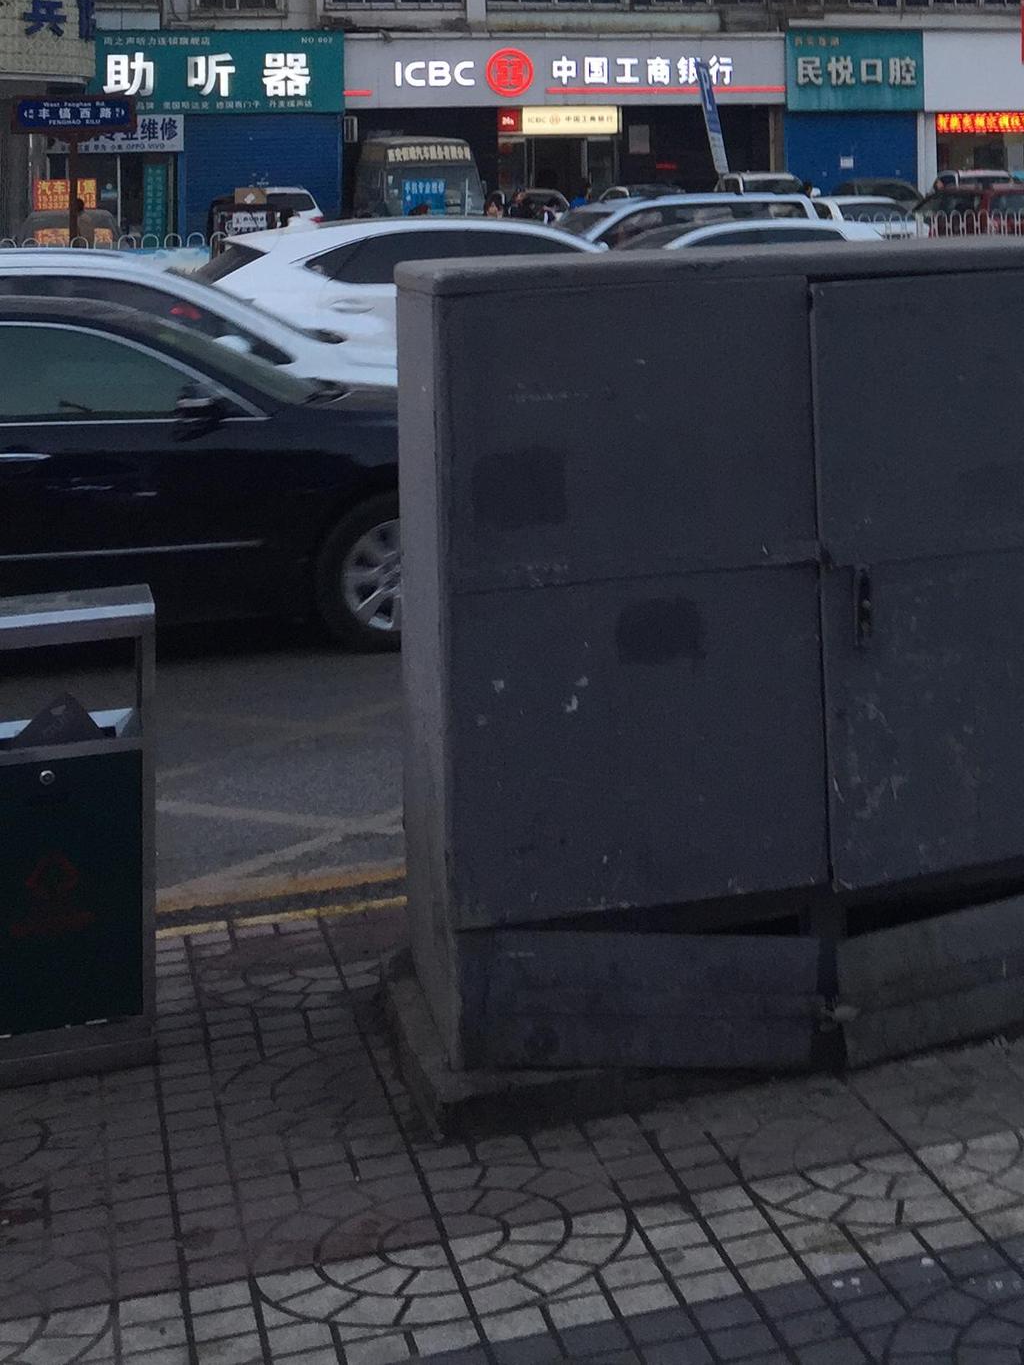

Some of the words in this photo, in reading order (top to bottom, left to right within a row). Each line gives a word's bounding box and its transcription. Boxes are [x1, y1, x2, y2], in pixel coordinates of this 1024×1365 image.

[102, 52, 311, 97] 助听器
[395, 61, 476, 87] ICBC
[552, 55, 733, 84] 中国工商银行
[797, 56, 916, 86] 民悦口腔
[38, 107, 112, 120] 丰镐西路
[527, 116, 546, 124] ICBC
[565, 115, 613, 123] 中国工商银行
[126, 142, 146, 150] OPPO
